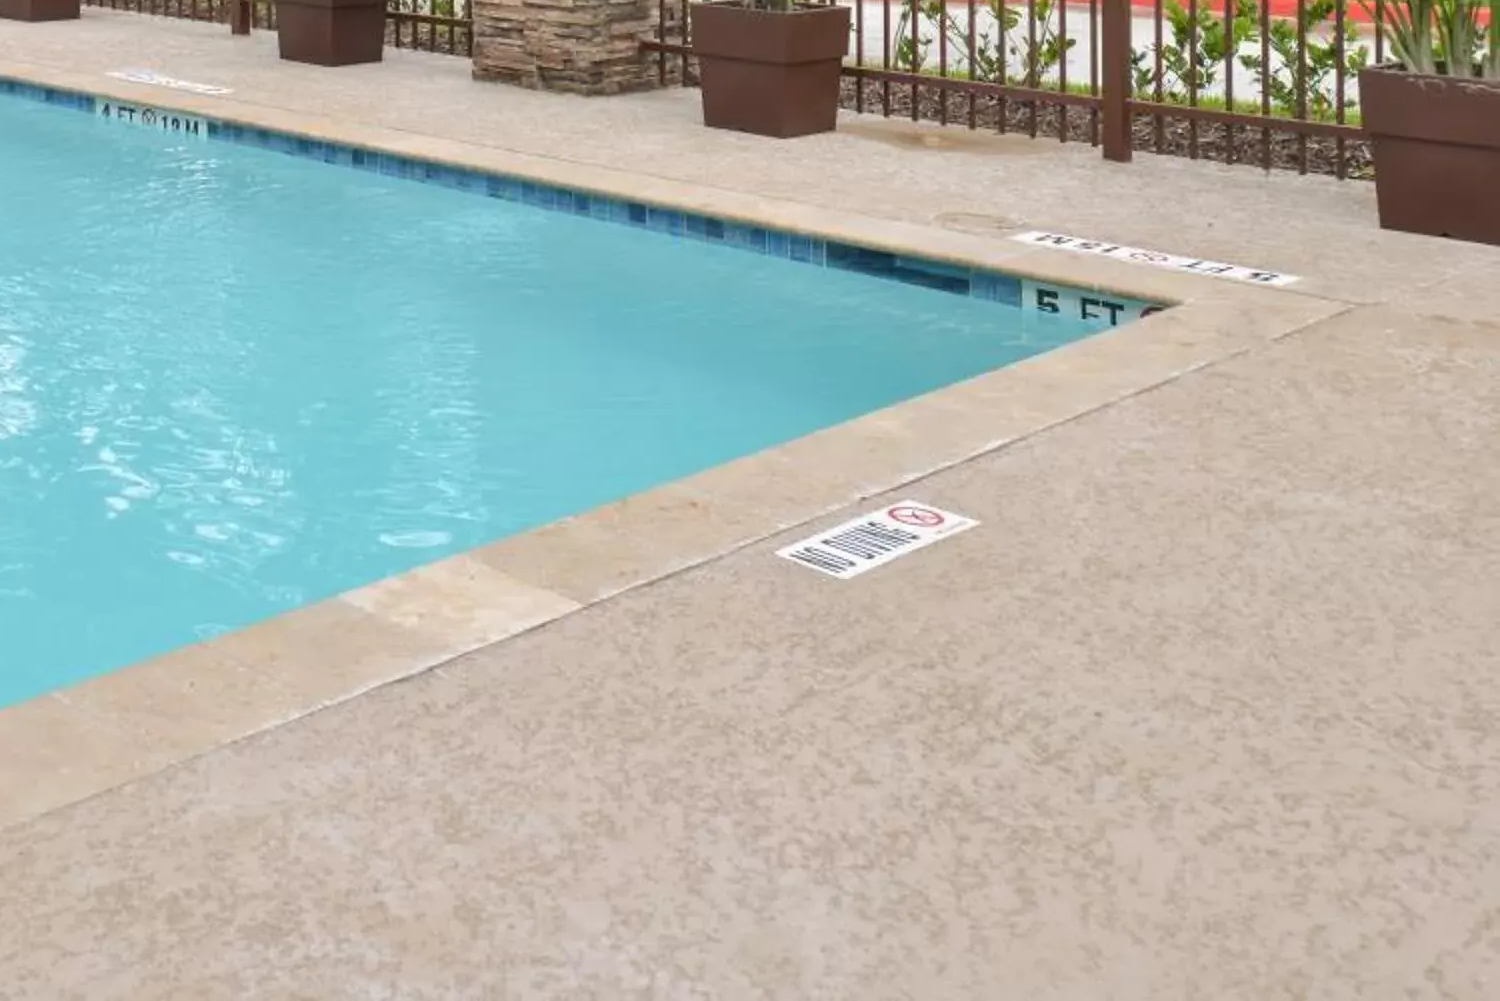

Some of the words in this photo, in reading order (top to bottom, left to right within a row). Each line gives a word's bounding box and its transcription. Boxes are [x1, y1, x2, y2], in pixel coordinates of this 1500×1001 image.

[1036, 288, 1060, 314] 5
[1080, 297, 1125, 326] FT
[820, 520, 921, 560] DIVING
[789, 546, 857, 574] NO
